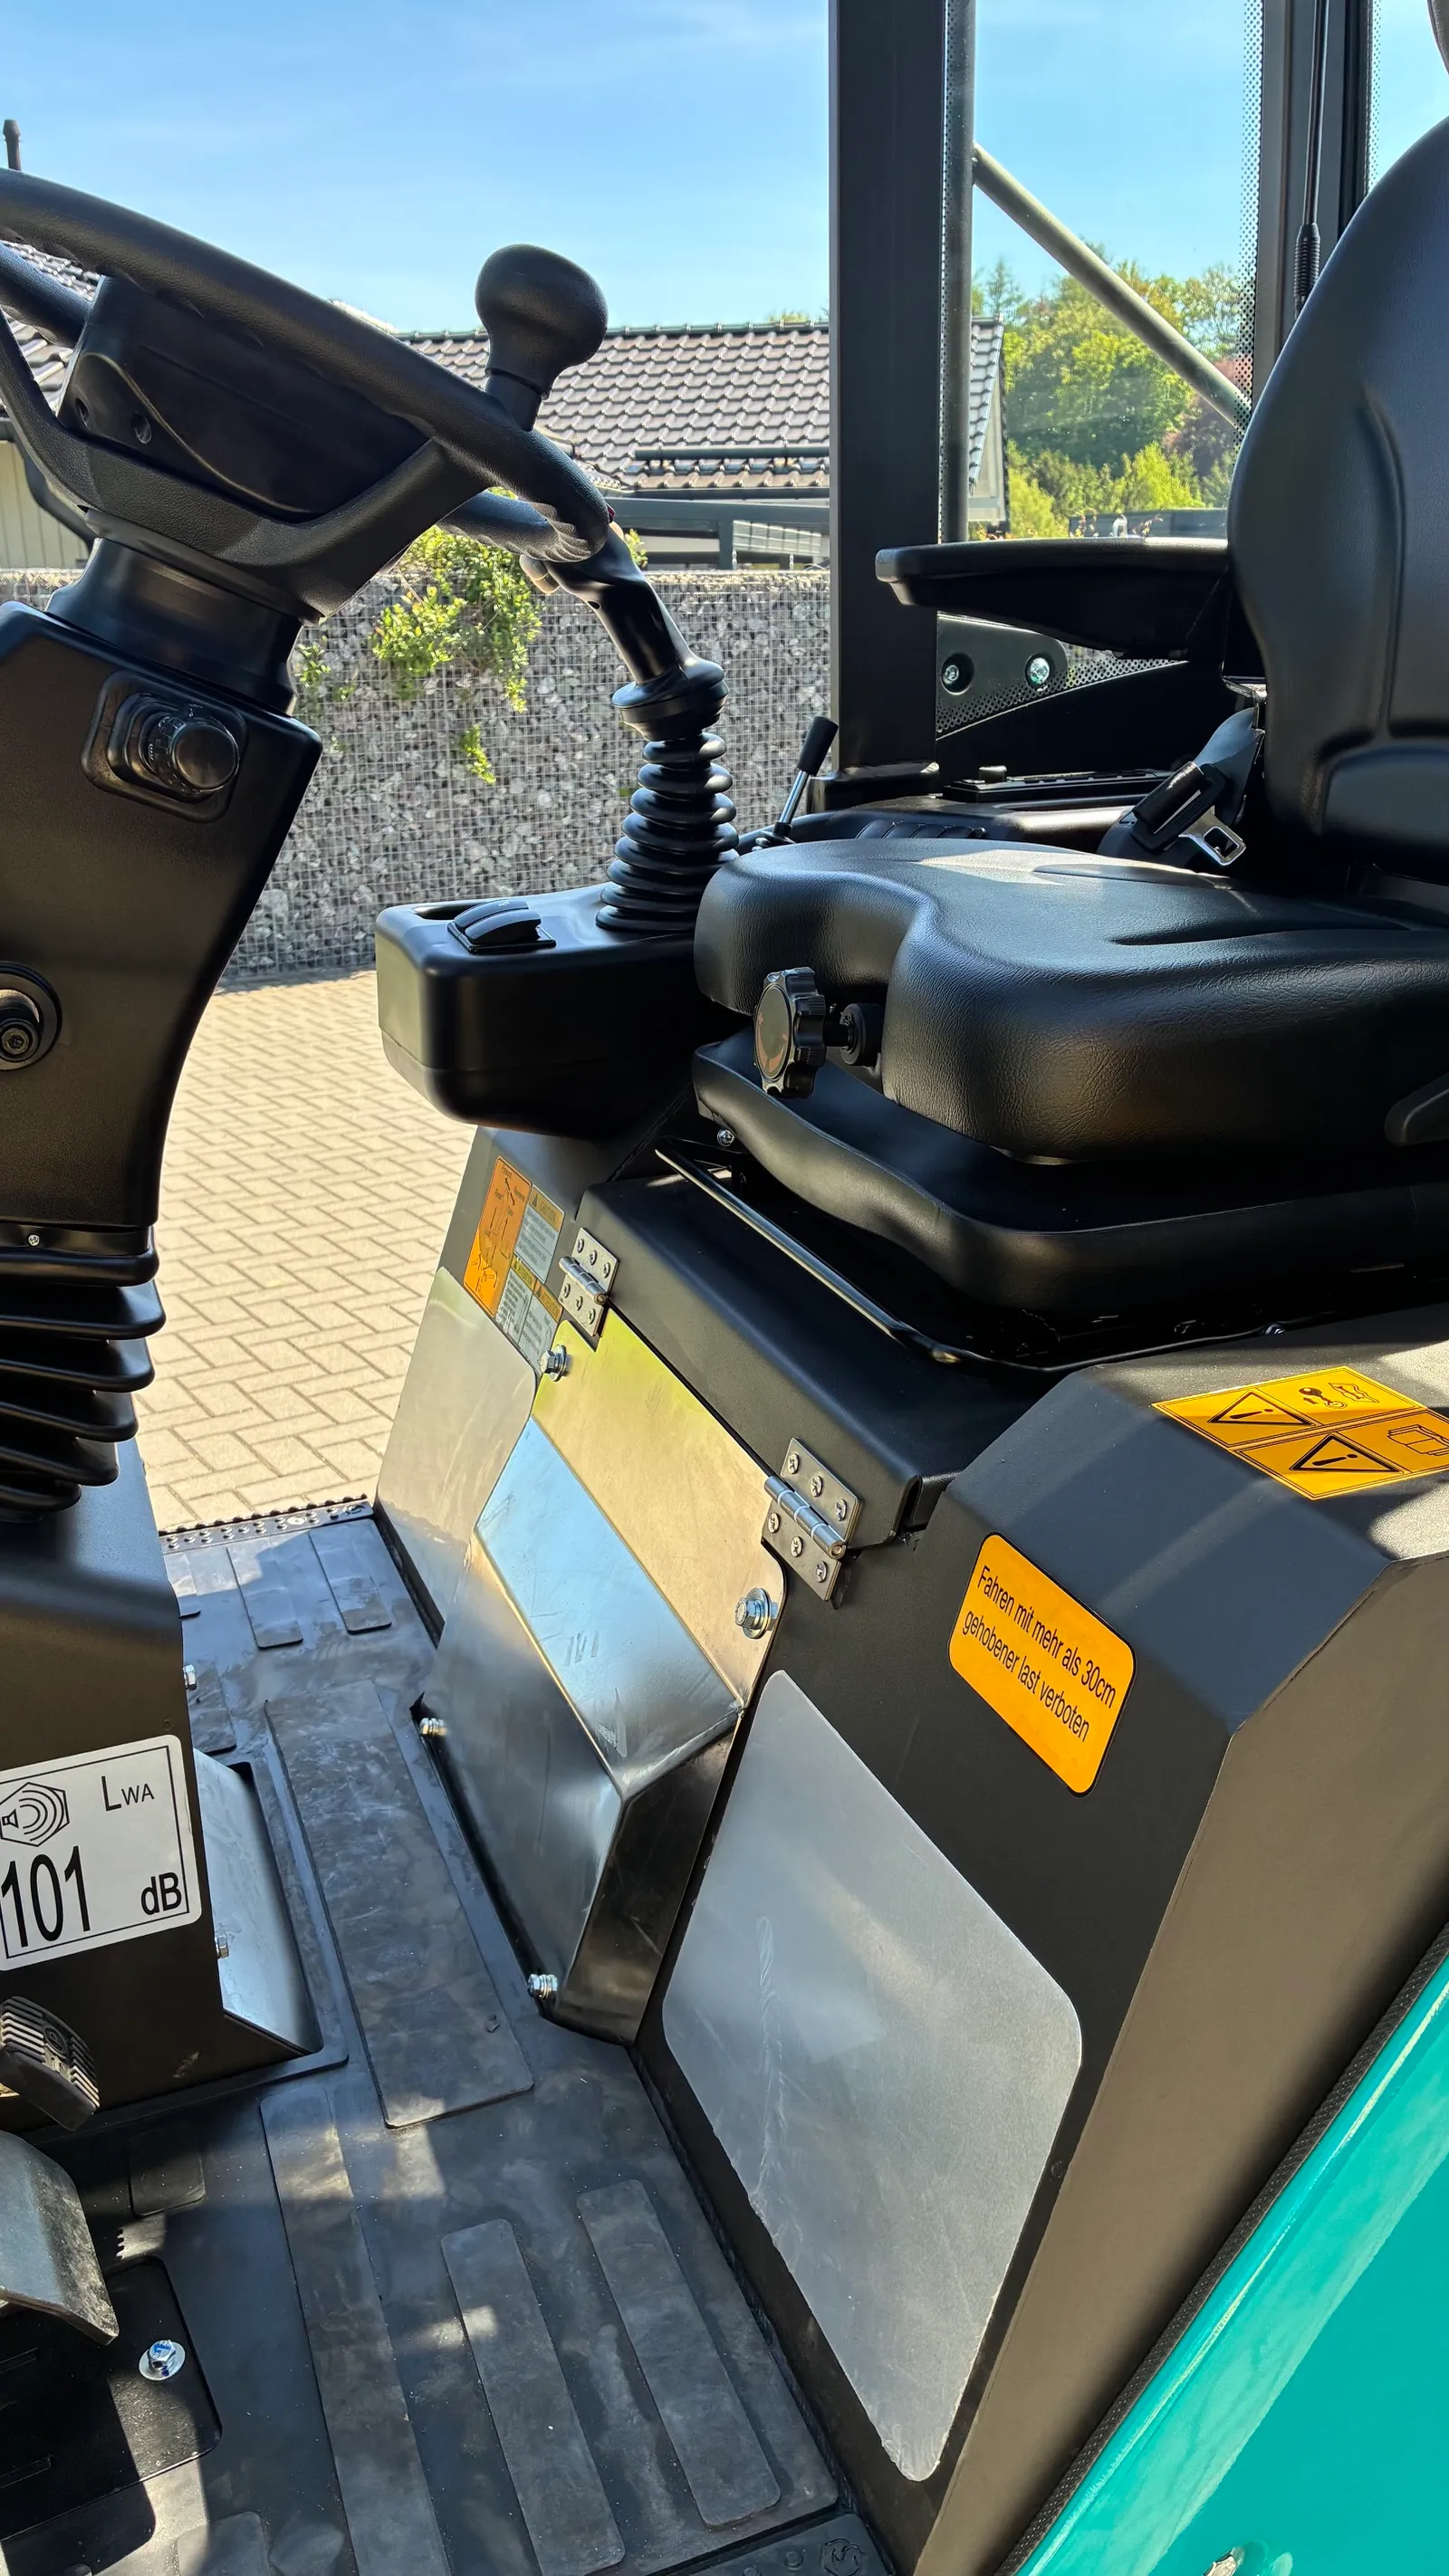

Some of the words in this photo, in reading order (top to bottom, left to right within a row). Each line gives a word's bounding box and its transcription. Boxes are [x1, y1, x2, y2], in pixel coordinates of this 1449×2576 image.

[963, 1610, 1021, 1673] gehobener
[1017, 1655, 1041, 1694] last
[1039, 1681, 1090, 1742] verboten
[977, 1565, 1015, 1616] Fahren
[1013, 1603, 1034, 1633] mit
[1032, 1620, 1064, 1660] mehr
[1061, 1646, 1081, 1677] als
[1080, 1660, 1117, 1709] 30cm
[1, 1845, 91, 1948] 101
[140, 1872, 182, 1916] dB
